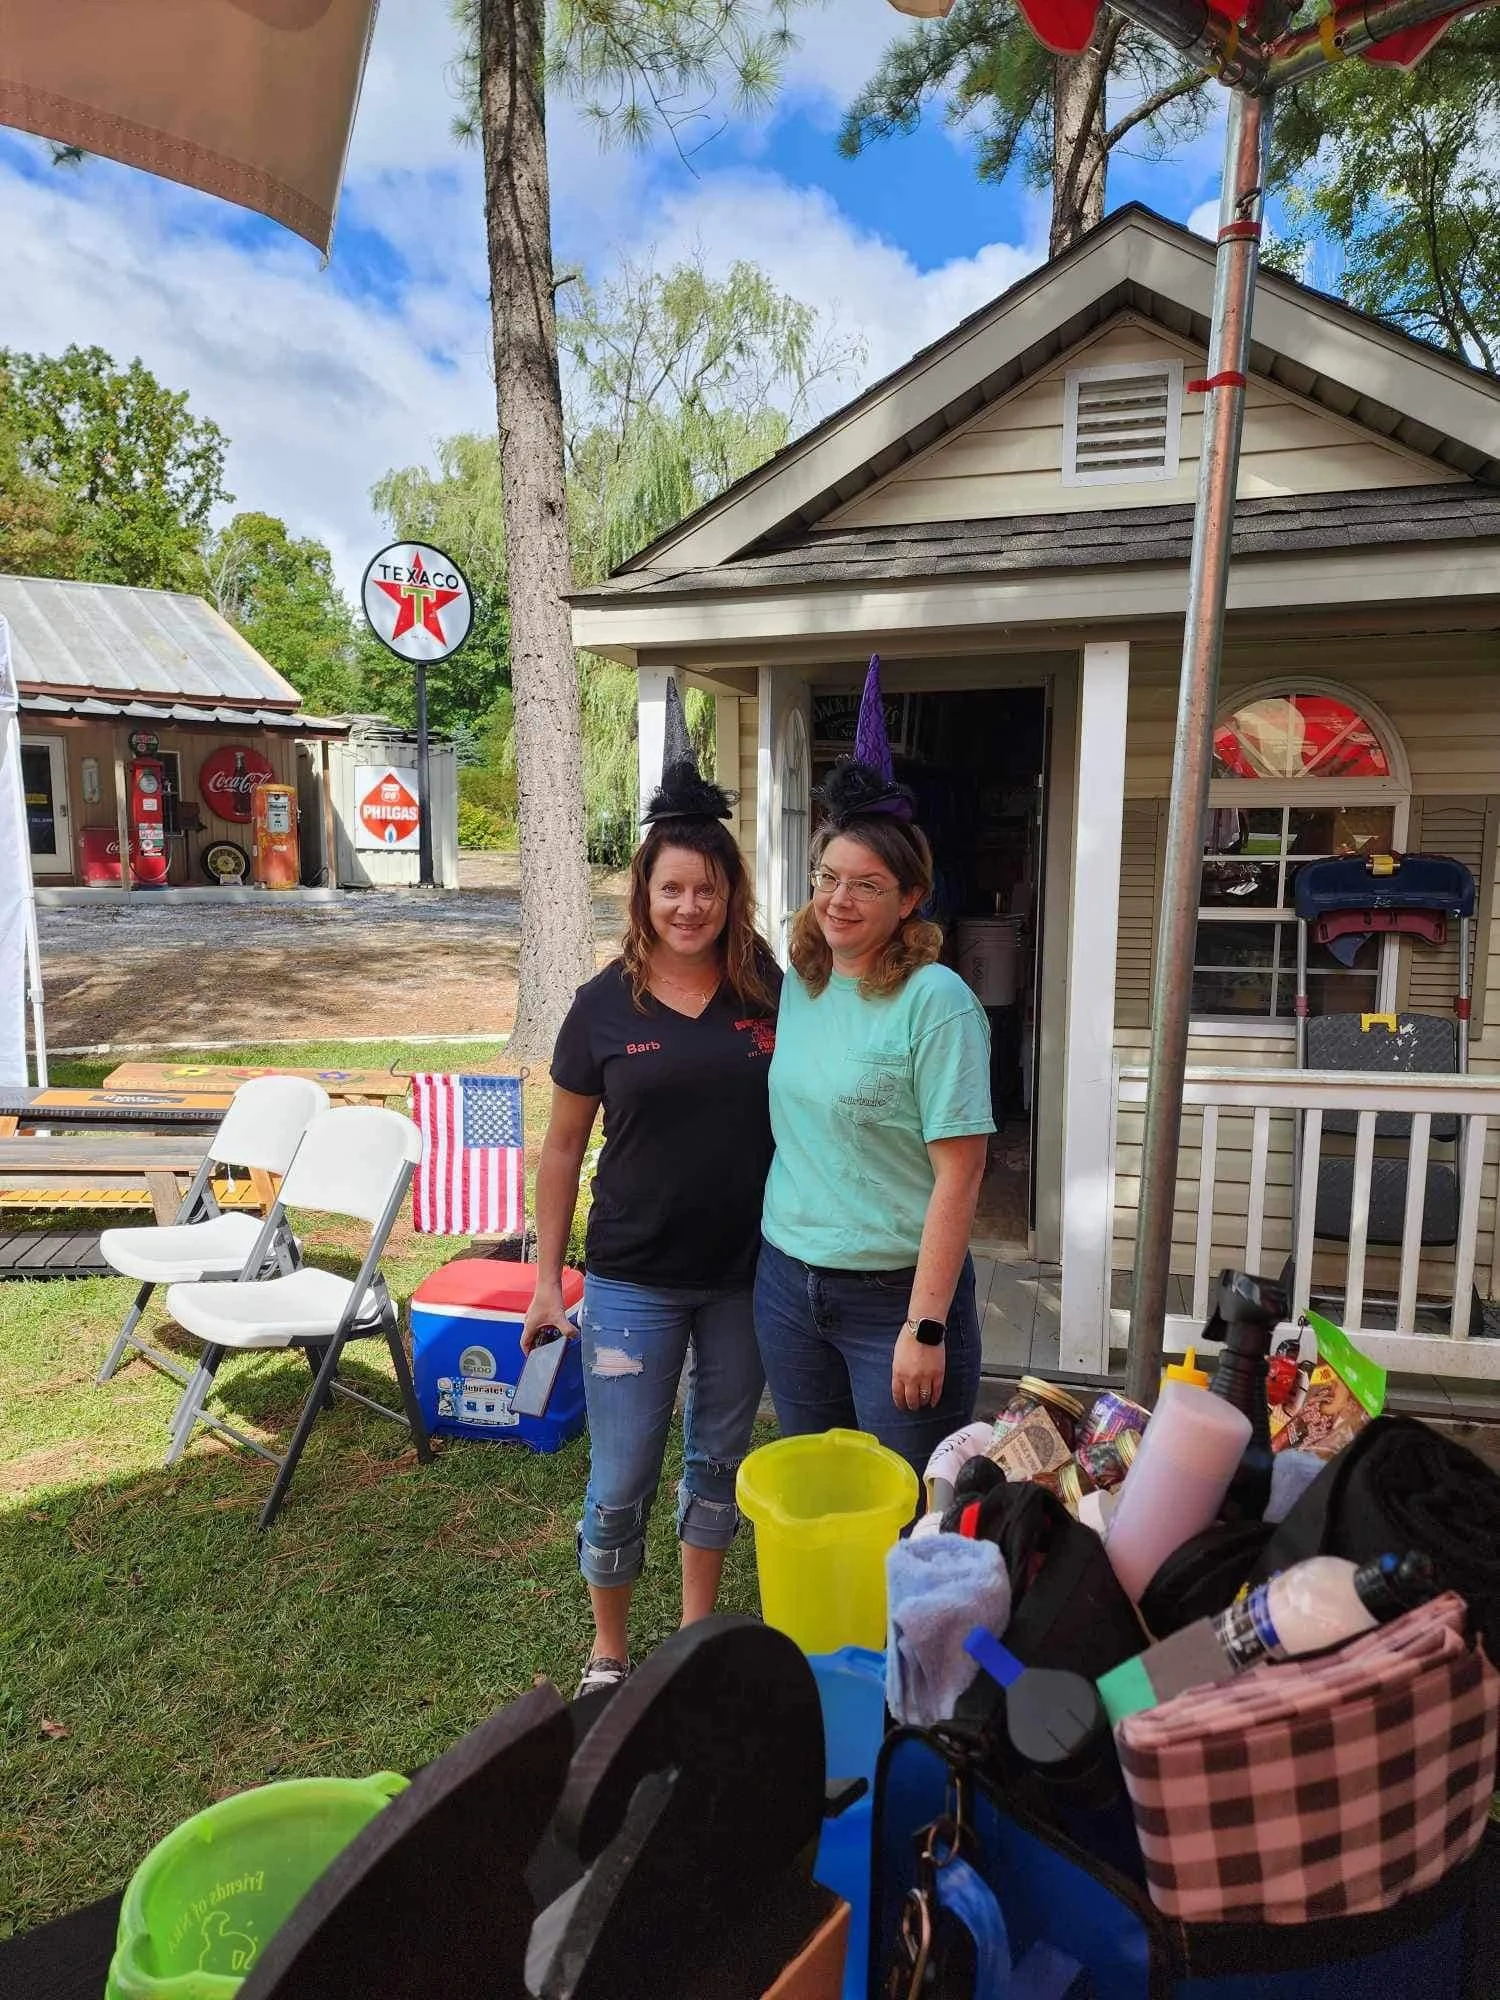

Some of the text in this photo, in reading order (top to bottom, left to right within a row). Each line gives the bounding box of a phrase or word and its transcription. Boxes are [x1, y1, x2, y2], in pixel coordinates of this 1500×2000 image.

[379, 564, 459, 589] TEXACO
[401, 585, 437, 626] T
[208, 770, 273, 793] Coca-Col
[362, 805, 418, 820] PHILGAS
[626, 1041, 661, 1054] Barb
[453, 1382, 503, 1395] Celebrate!
